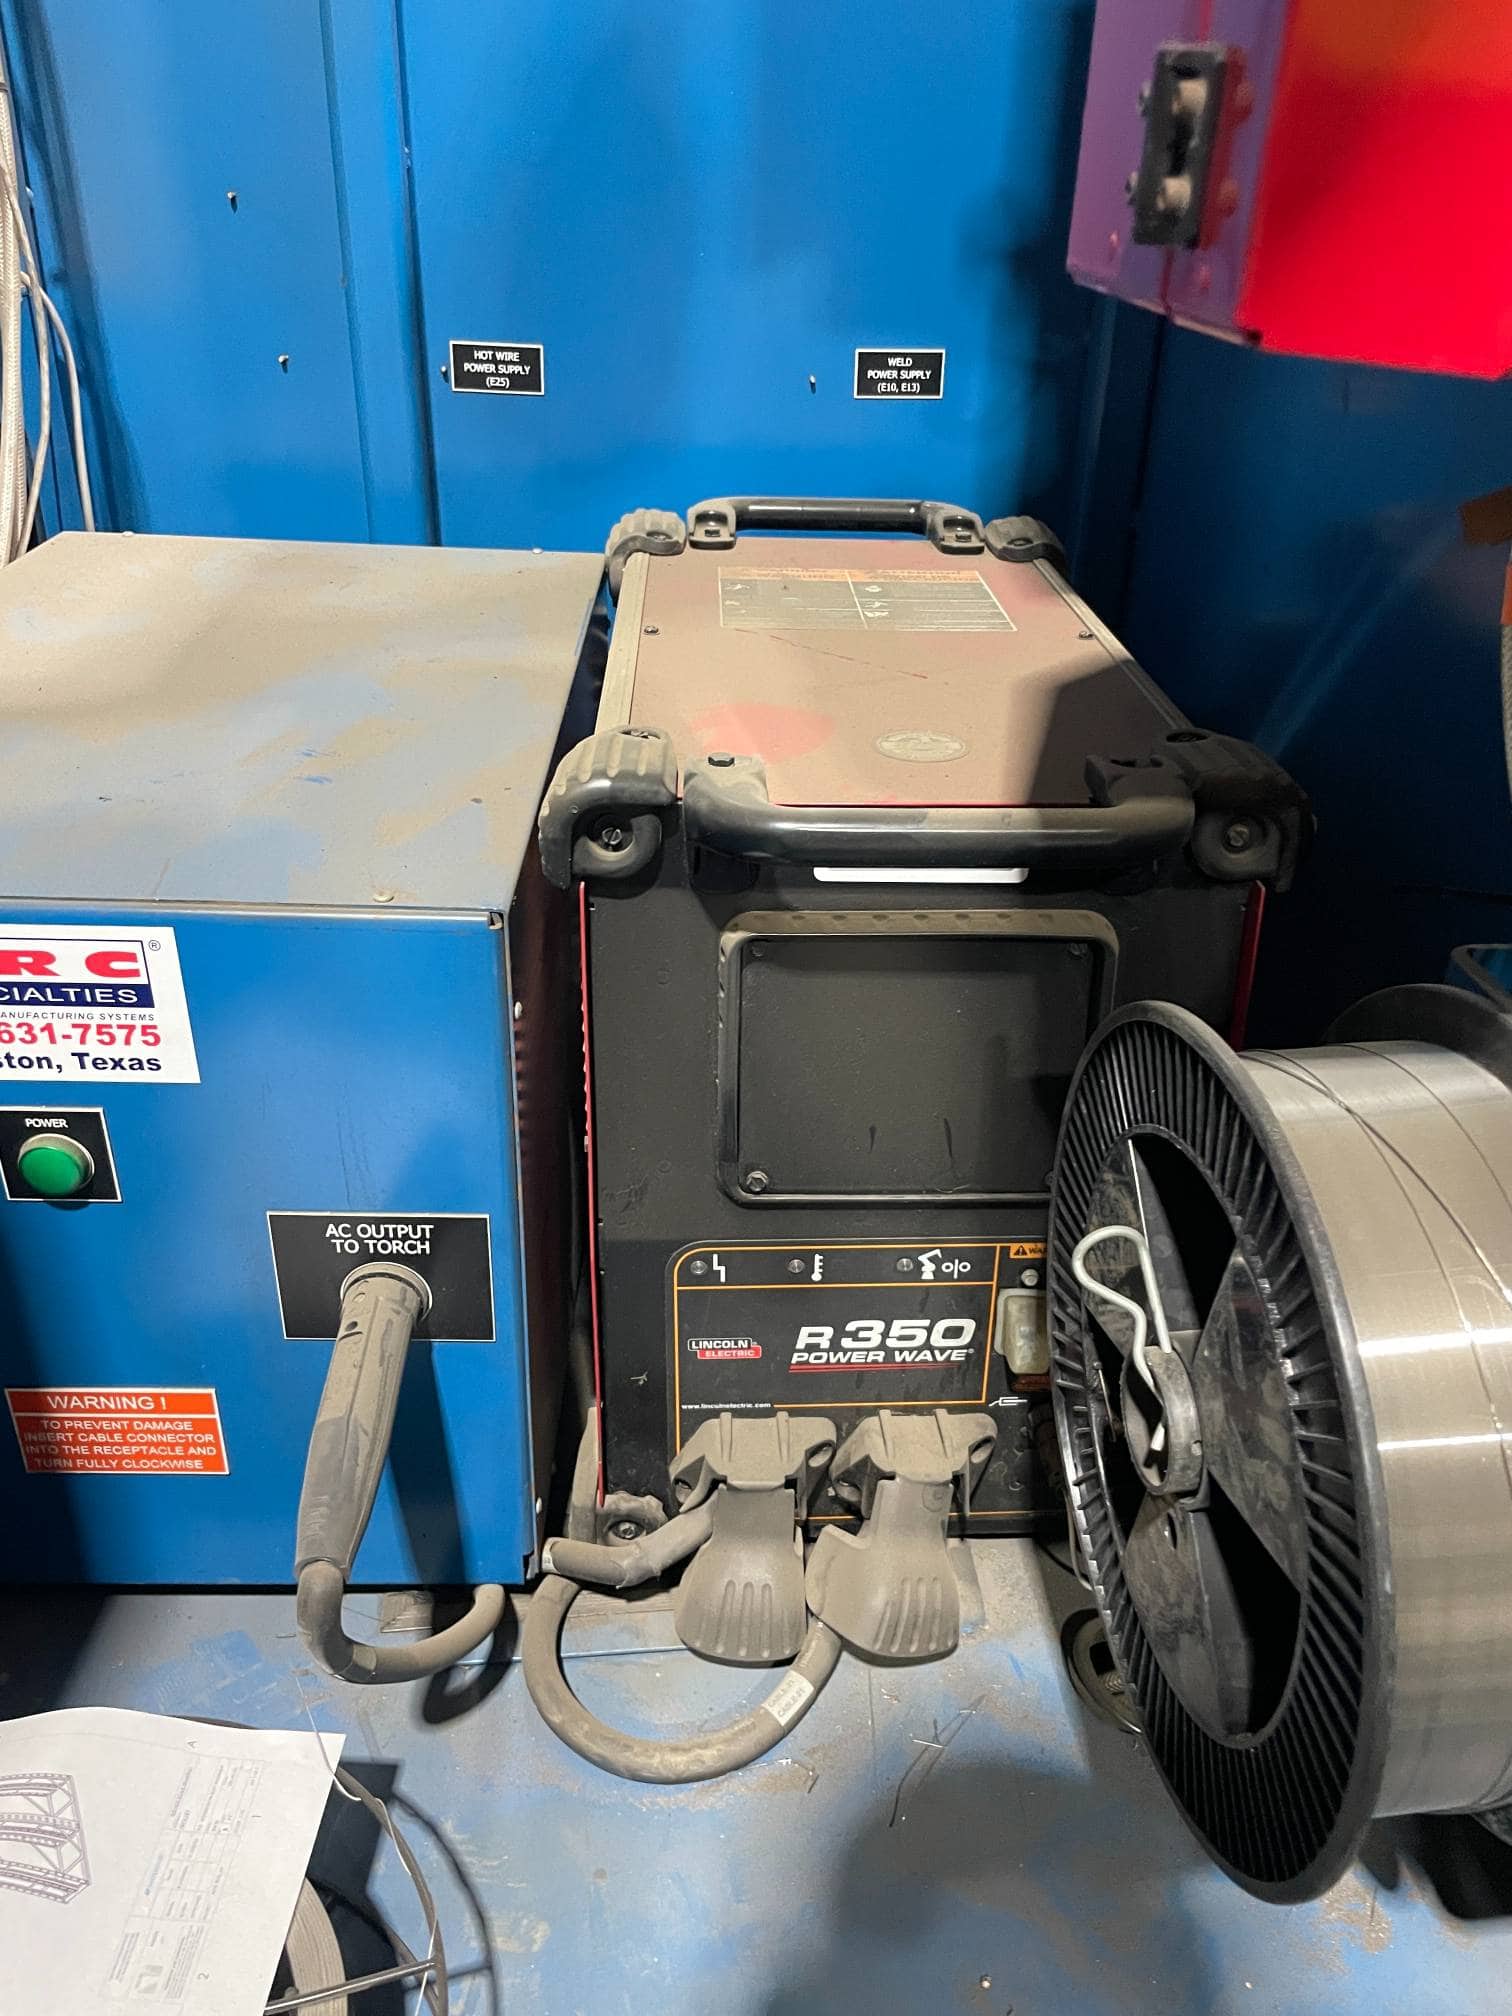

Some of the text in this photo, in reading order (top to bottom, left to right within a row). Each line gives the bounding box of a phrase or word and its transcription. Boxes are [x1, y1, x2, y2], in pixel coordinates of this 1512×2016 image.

[474, 350, 520, 361] HOT WIRE
[887, 357, 913, 367] WELD
[463, 362, 530, 375] POWER SUPPLY
[867, 370, 931, 379] POWER SUPPLY
[486, 376, 509, 389] (E25)
[877, 382, 920, 394] (E10, E13)
[99, 1013, 155, 1021] SYSTEMS
[70, 1052, 162, 1072] Texas
[25, 1118, 69, 1129] POWER
[325, 1223, 434, 1240] AC OUTPUT
[331, 1239, 430, 1255] TO TORCH
[691, 1340, 748, 1349] LINCOLN
[705, 1349, 756, 1357] ELECTRIC
[791, 1349, 973, 1364] POWER WAVE
[47, 1396, 167, 1410] WARNING !
[40, 1420, 192, 1430] TO PREVENT DAMAGE
[25, 1432, 215, 1443] INSERT CABLE CONNECTOR
[26, 1445, 216, 1456] INTO THE RECEPTACLE AND
[35, 1458, 204, 1469] TURN FULLY CLOCKWISE
